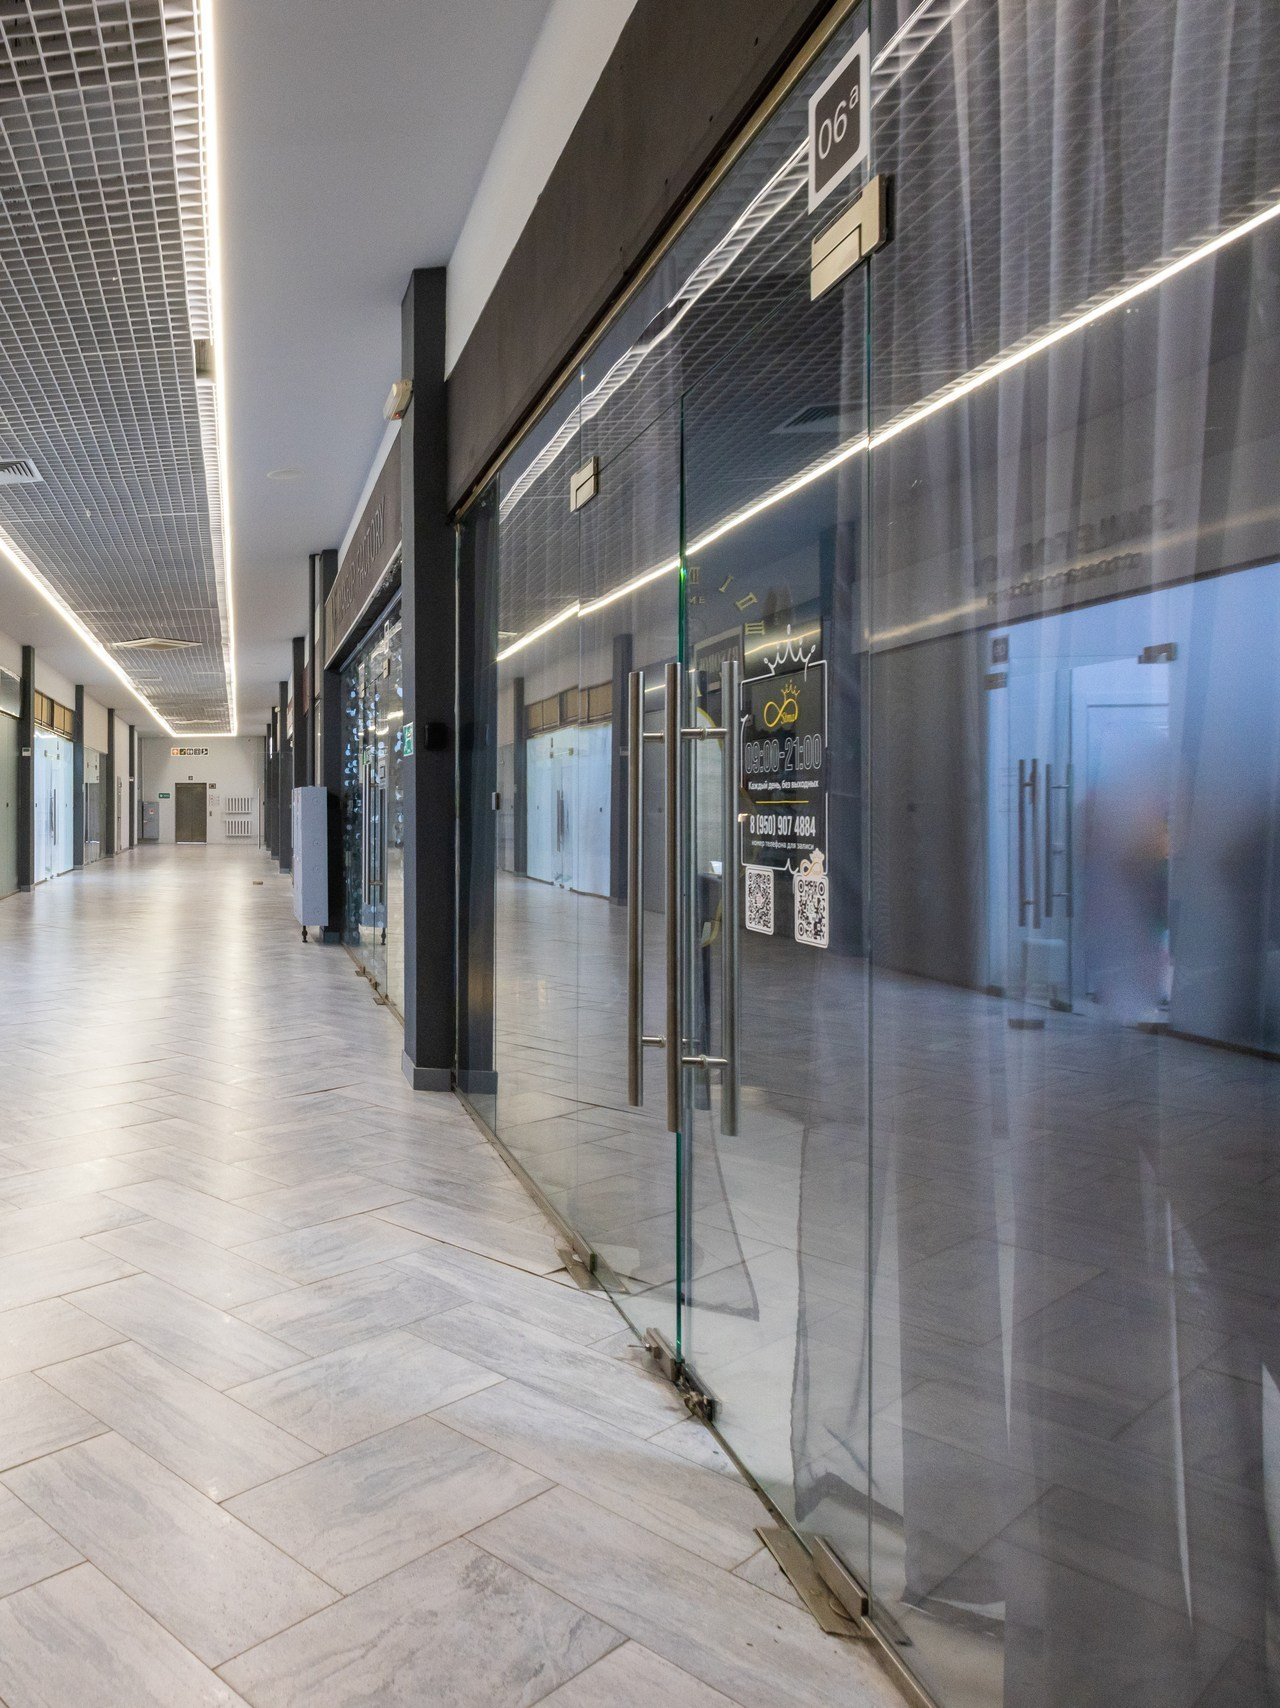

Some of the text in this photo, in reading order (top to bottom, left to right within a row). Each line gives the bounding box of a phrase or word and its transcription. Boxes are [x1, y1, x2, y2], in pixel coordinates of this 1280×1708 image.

[745, 733, 822, 774] 09:00-21:00
[748, 780, 768, 790] Каждый
[781, 779, 791, 789] без
[791, 780, 819, 789] выходных
[749, 814, 816, 837] 8 (950) 907 4884
[751, 840, 765, 848] номер
[765, 840, 786, 849] телефона
[787, 842, 796, 850] для
